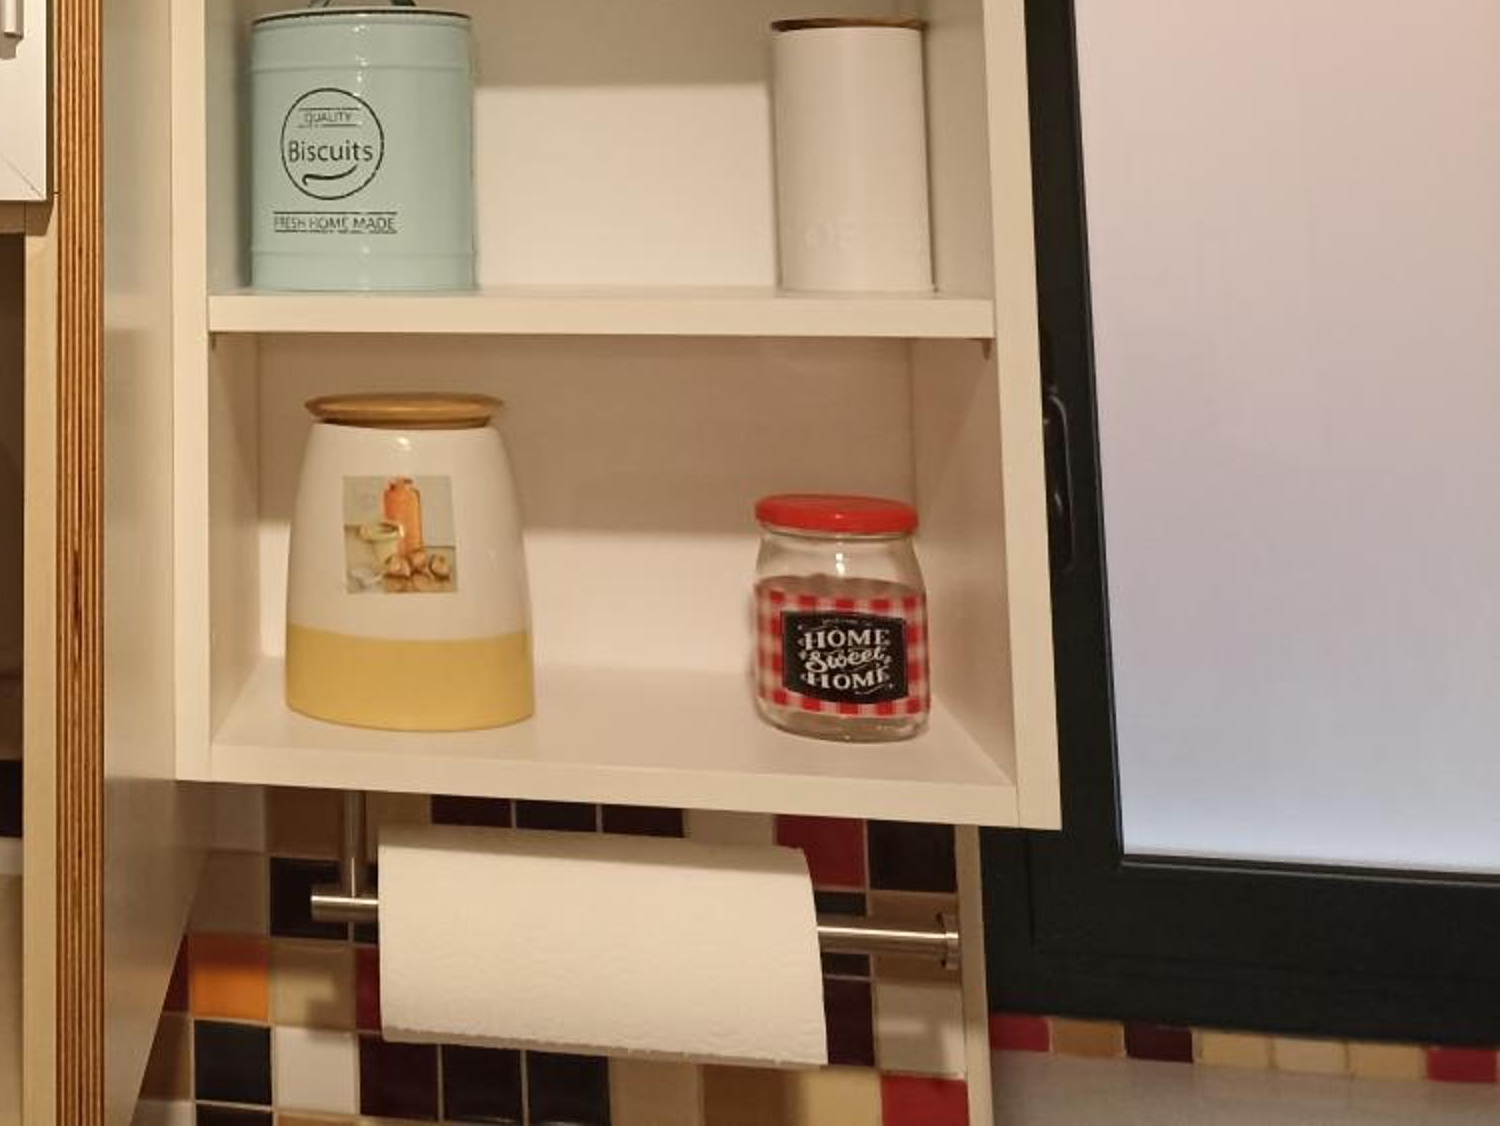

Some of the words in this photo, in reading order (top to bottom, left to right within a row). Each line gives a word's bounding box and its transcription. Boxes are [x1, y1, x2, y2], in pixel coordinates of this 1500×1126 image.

[304, 112, 352, 124] QUALITY
[287, 139, 374, 163] Biscuits
[274, 216, 307, 229] FRESH
[309, 216, 348, 229] HOME
[353, 216, 396, 229] MADE
[804, 629, 887, 651] HOME
[805, 647, 885, 673] Sweet
[806, 667, 888, 690] HOME
